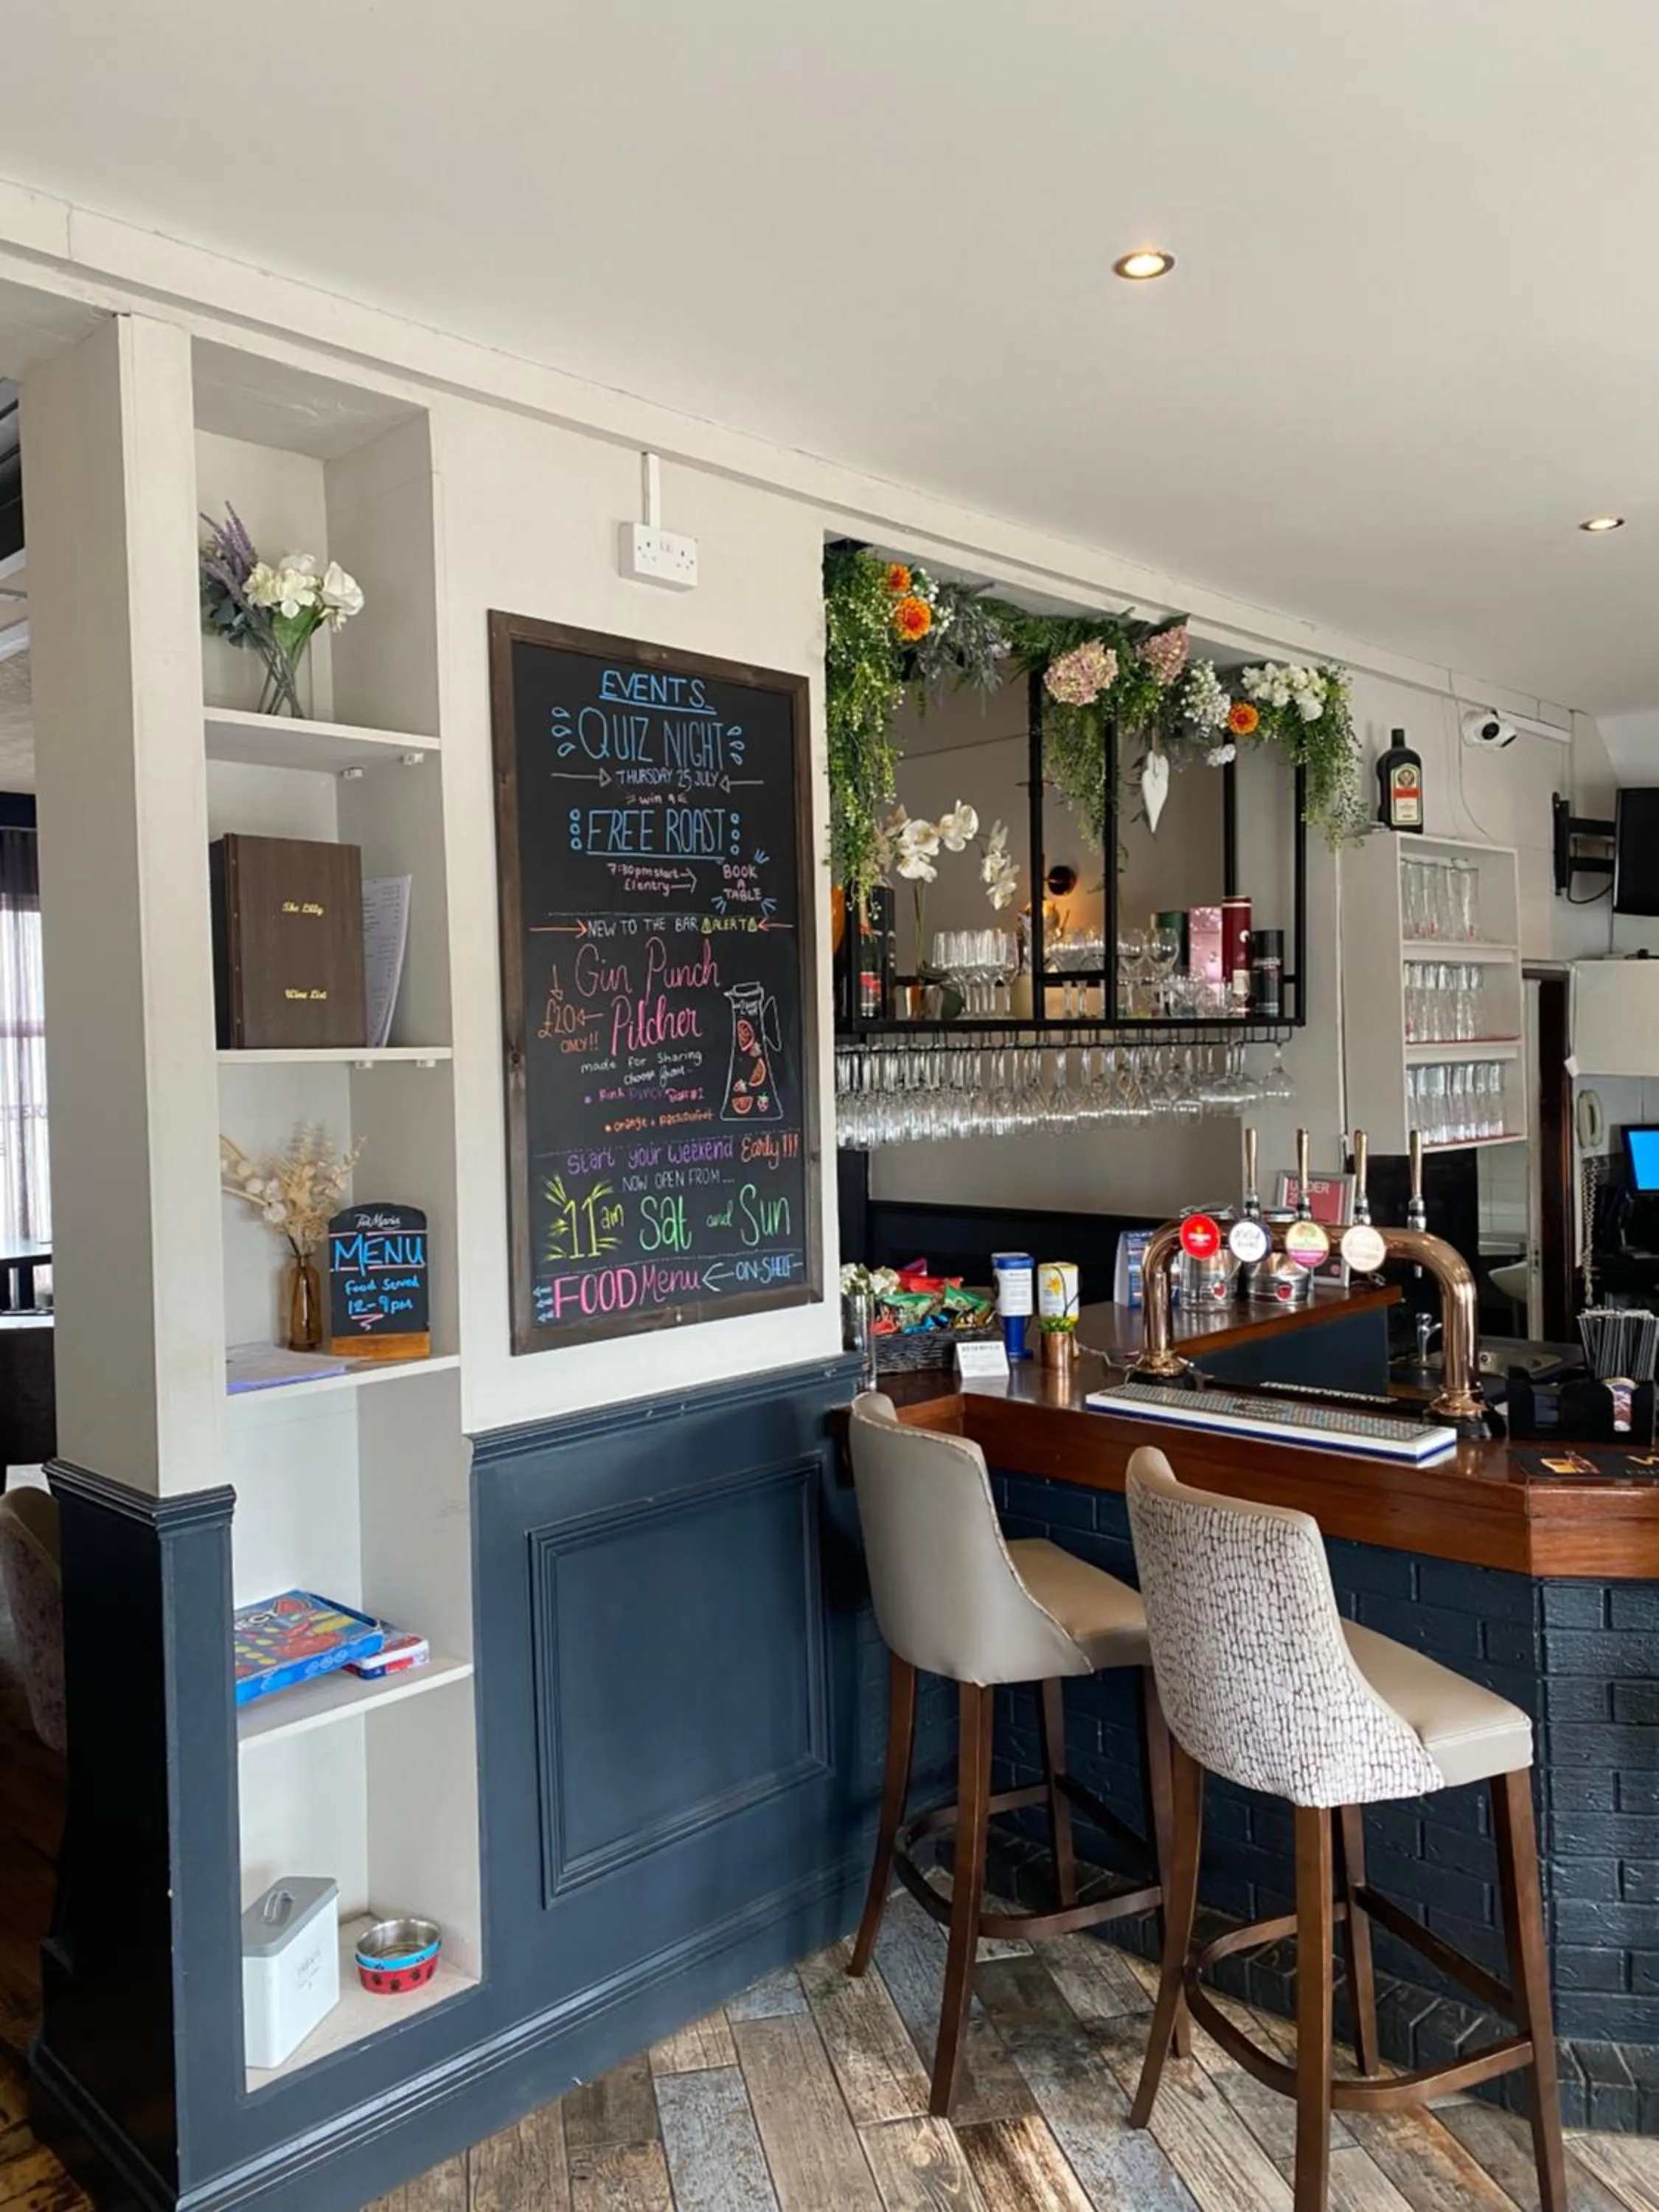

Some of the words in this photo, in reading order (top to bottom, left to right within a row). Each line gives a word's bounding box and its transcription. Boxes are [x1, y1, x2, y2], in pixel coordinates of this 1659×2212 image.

[601, 669, 711, 709] EVENTS
[578, 706, 654, 762] QUIZ
[663, 719, 724, 770] NIGHT
[615, 768, 674, 785] THURSDAY
[676, 768, 693, 793] 25
[694, 771, 720, 787] JULY
[588, 809, 655, 851] FREE
[665, 809, 726, 853] ROAST
[722, 863, 758, 880] BOOK
[737, 879, 746, 889] A
[723, 887, 763, 902] TABLE
[588, 919, 617, 938] NEW
[620, 919, 639, 935] TO
[643, 917, 666, 932] THE
[674, 917, 699, 933] BAR
[575, 943, 633, 998] Gin
[644, 936, 720, 1005] Punch
[285, 989, 308, 999] Wine
[537, 999, 576, 1039] £20
[567, 1147, 616, 1175] Start
[627, 1146, 662, 1169] your
[622, 1174, 648, 1192] NOW
[654, 1169, 685, 1189] OPEN
[1289, 1179, 1329, 1194] UDER
[639, 1194, 692, 1251] Sat
[706, 1200, 734, 1228] and
[740, 1183, 790, 1246] Sun
[335, 1234, 425, 1276] MENU
[345, 1279, 377, 1295] Food
[381, 1275, 420, 1291] Served
[553, 1268, 637, 1320] FOOD
[639, 1264, 701, 1308] Menu
